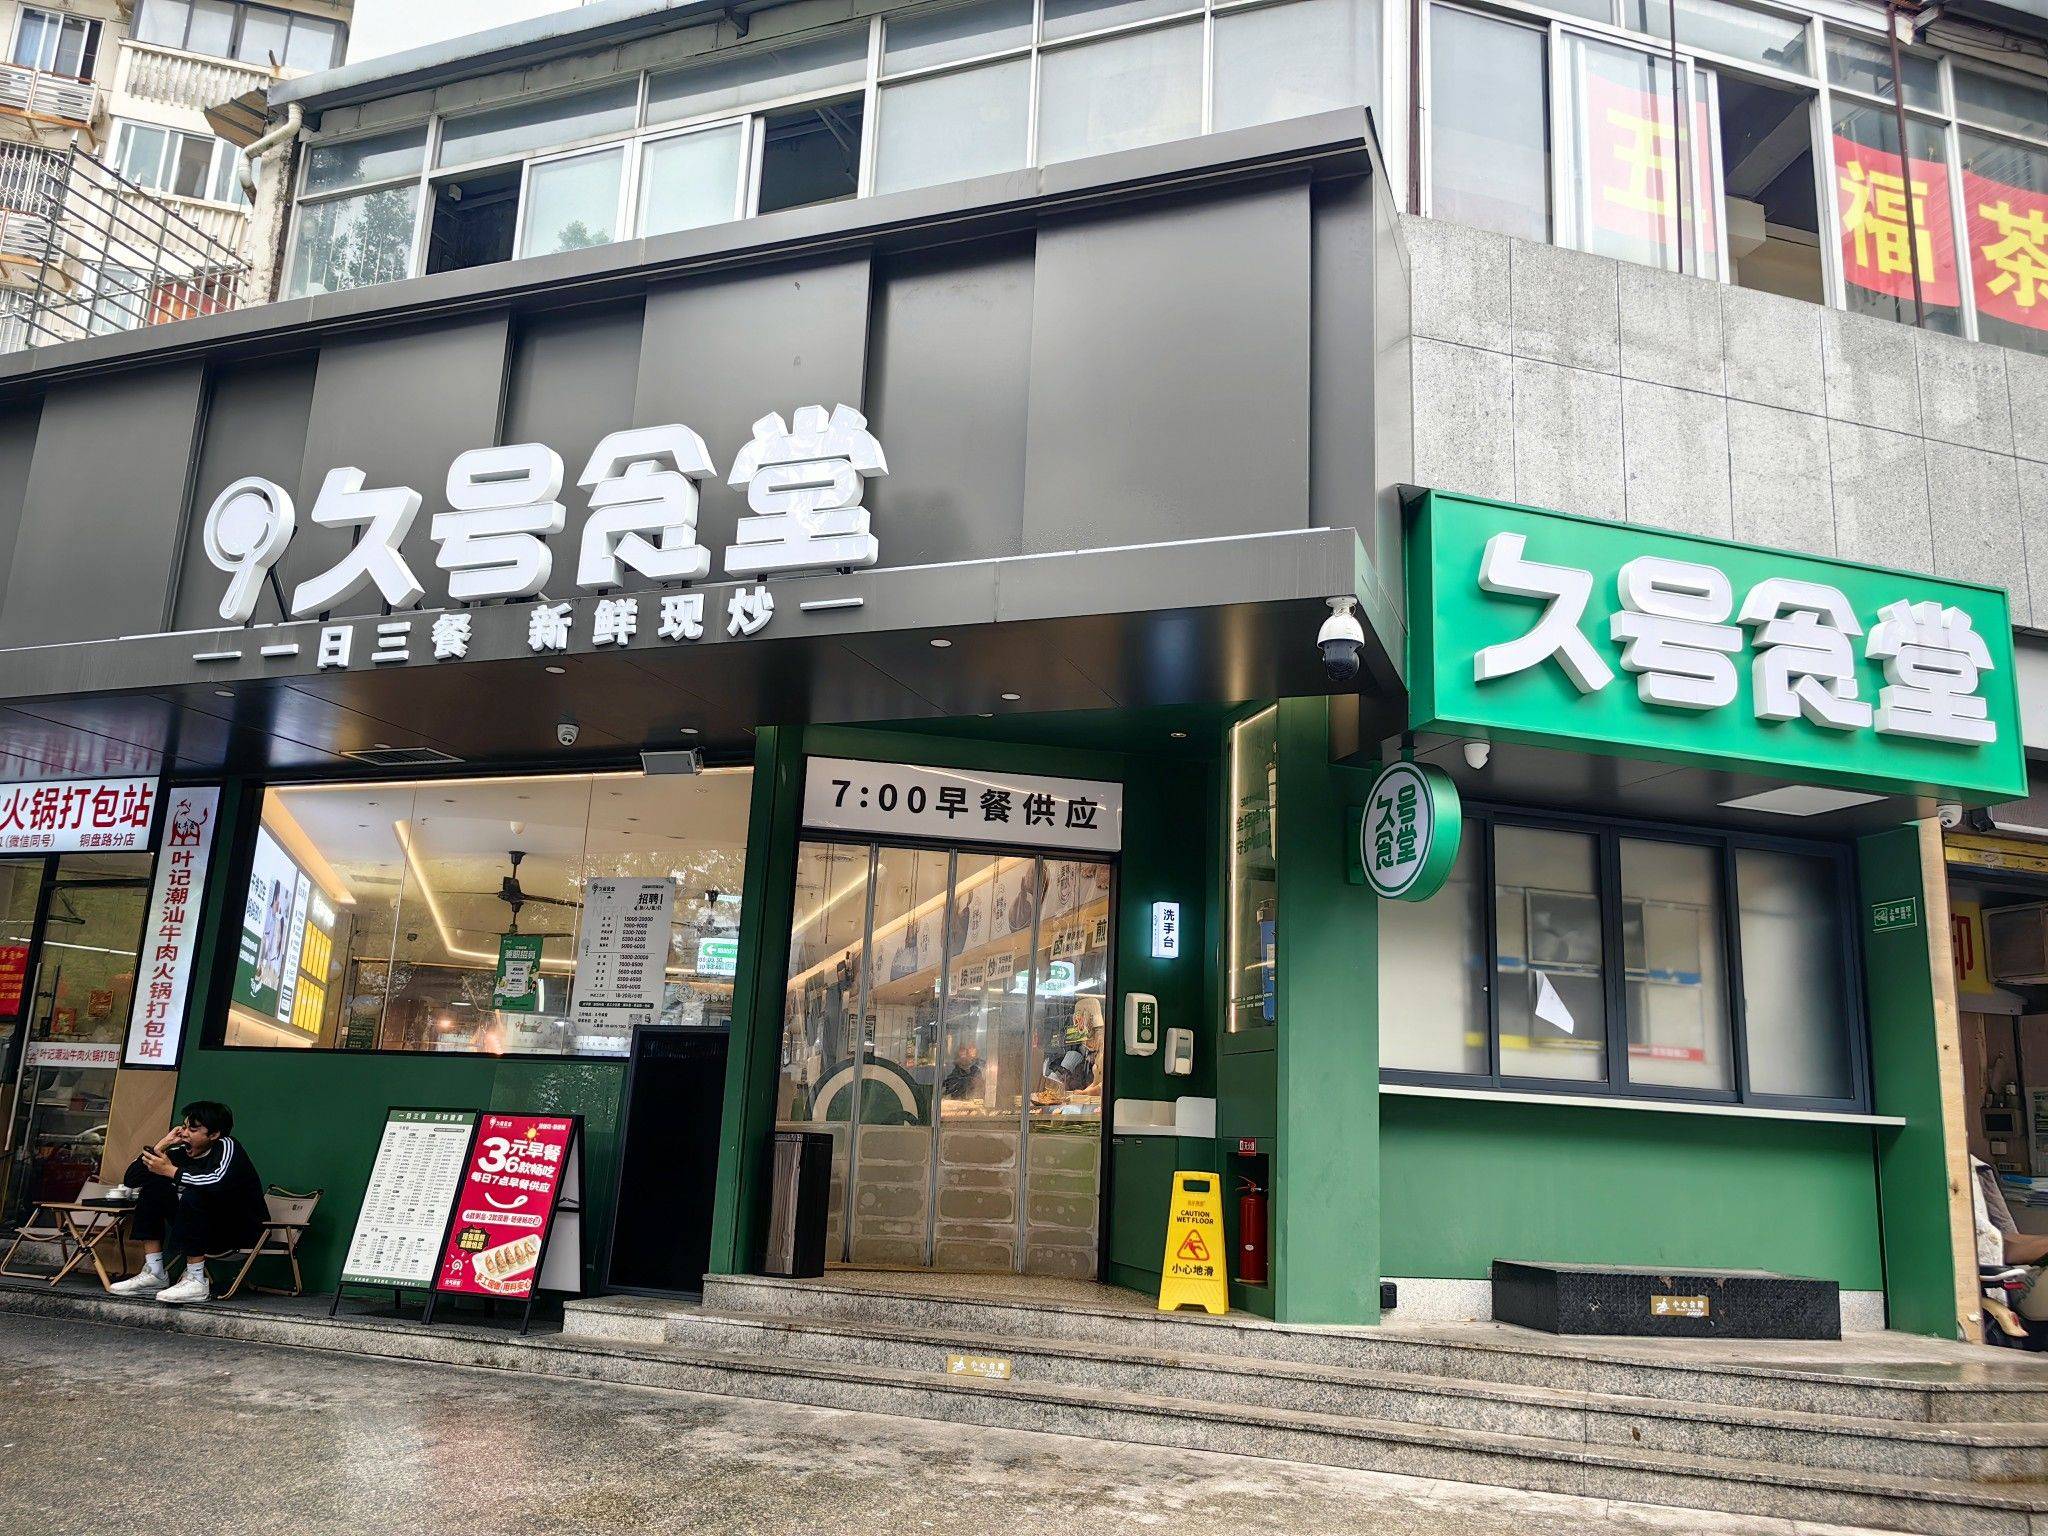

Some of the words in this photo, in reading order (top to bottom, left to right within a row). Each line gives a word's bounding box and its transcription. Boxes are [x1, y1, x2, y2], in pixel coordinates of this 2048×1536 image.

[292, 403, 889, 619] 久号食堂
[261, 613, 471, 669] 一日三餐
[528, 585, 775, 653] 新鲜现炒
[1474, 531, 1998, 746] 久号食堂
[831, 779, 1099, 830] 7:00早餐供应
[79, 832, 136, 848] 铜盘路分店
[1163, 908, 1175, 949] 洗手台
[139, 850, 195, 1058] 叶记潮汕牛肉火锅打包站
[1141, 1003, 1151, 1026] 纸巾
[471, 1171, 551, 1193] 每日7点早餐供应
[1180, 1209, 1210, 1217] CAUTION
[1191, 1217, 1214, 1225] FLOOR
[1172, 1263, 1214, 1277] 小心地滑
